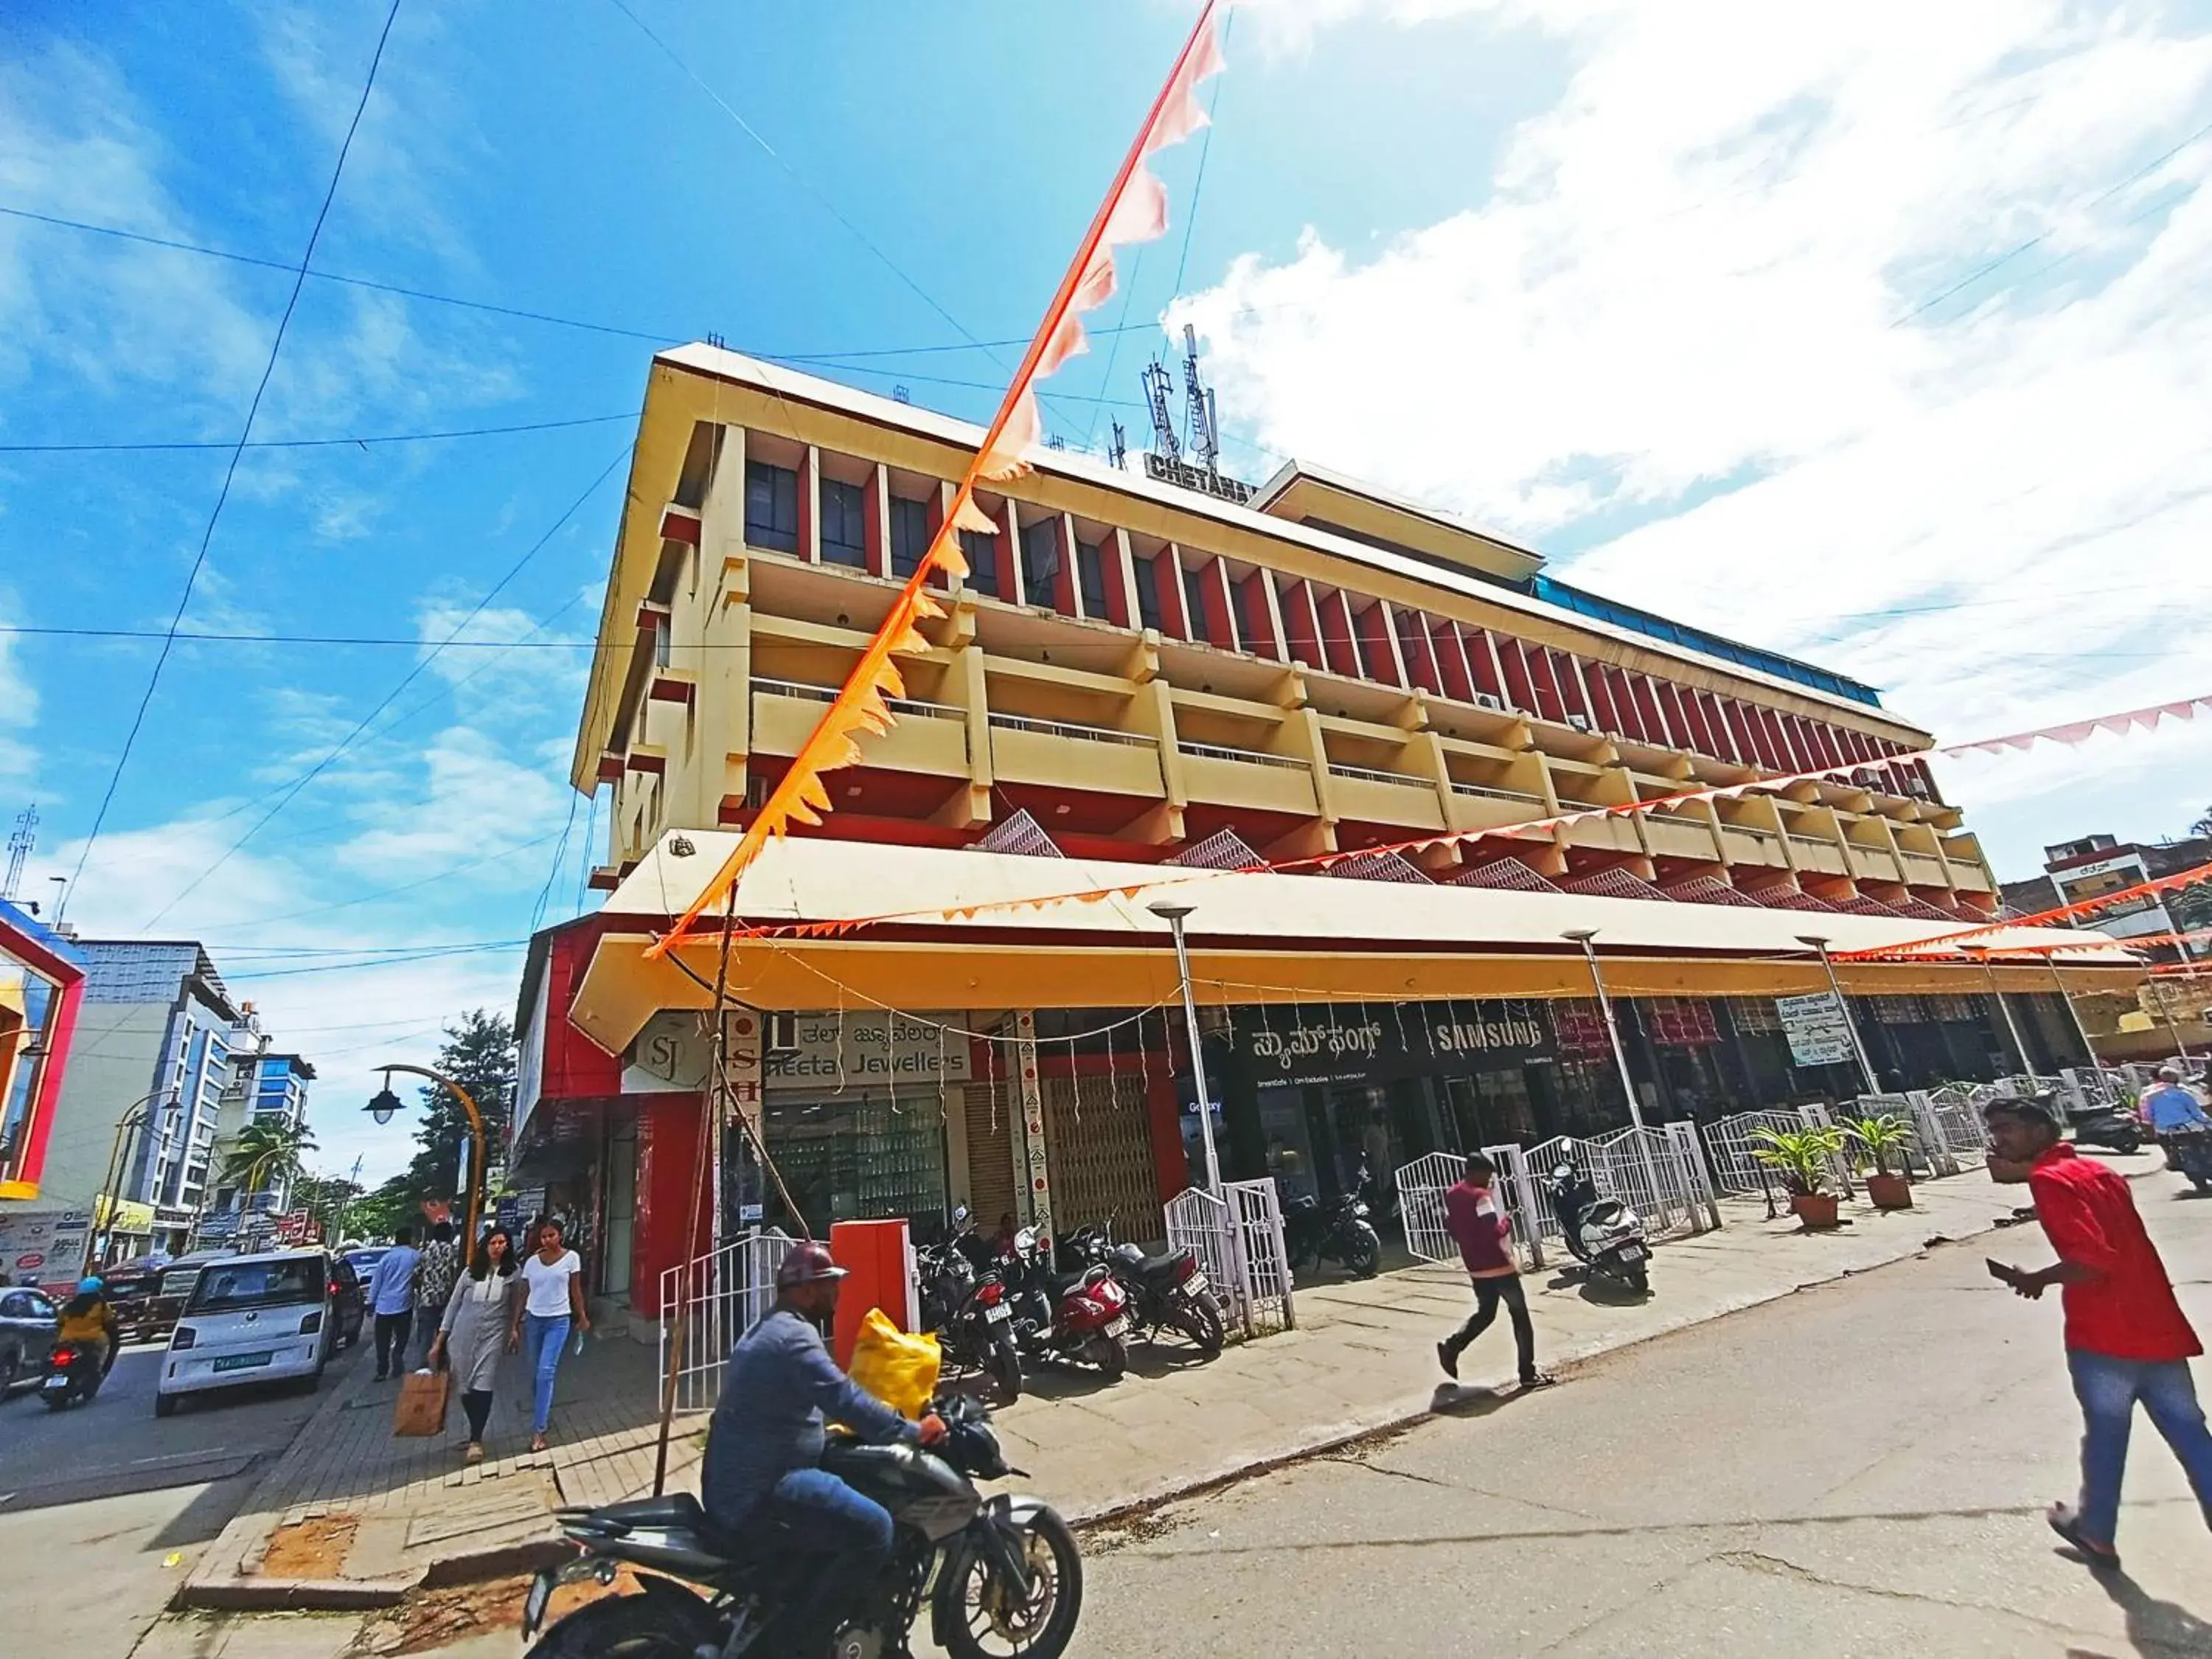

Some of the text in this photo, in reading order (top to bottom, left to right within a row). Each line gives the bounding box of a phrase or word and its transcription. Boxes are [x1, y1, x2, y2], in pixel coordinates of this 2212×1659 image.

[1437, 1020, 1542, 1051] SAMSUNG
[652, 1035, 678, 1081] SJ
[852, 1050, 964, 1074] Jewellers
